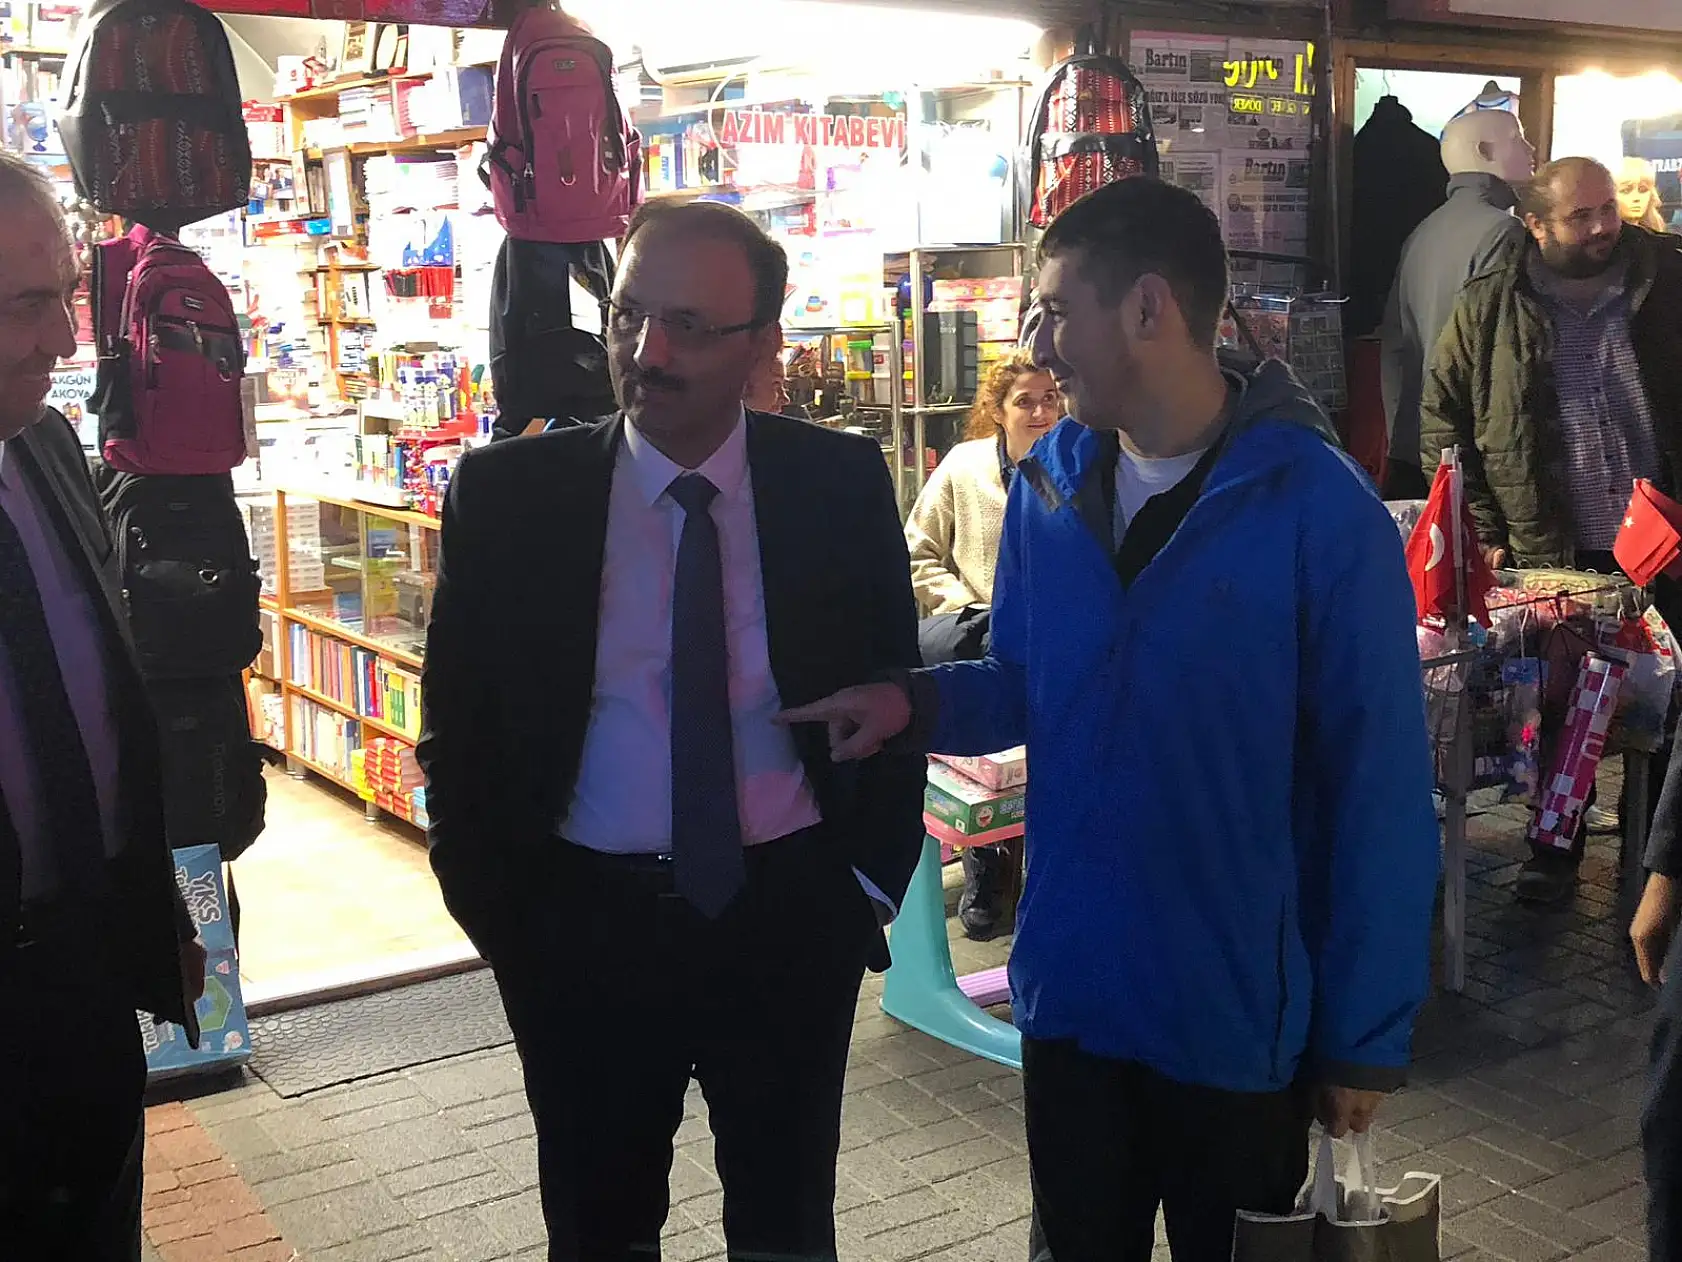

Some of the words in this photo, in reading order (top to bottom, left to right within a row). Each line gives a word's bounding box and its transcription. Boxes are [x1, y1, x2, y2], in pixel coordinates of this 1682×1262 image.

[721, 106, 785, 144] AZİM
[794, 110, 906, 149] KİTABEVİ
[50, 373, 92, 385] AKGÜN
[51, 388, 91, 399] AKOVA
[191, 871, 221, 924] YKS
